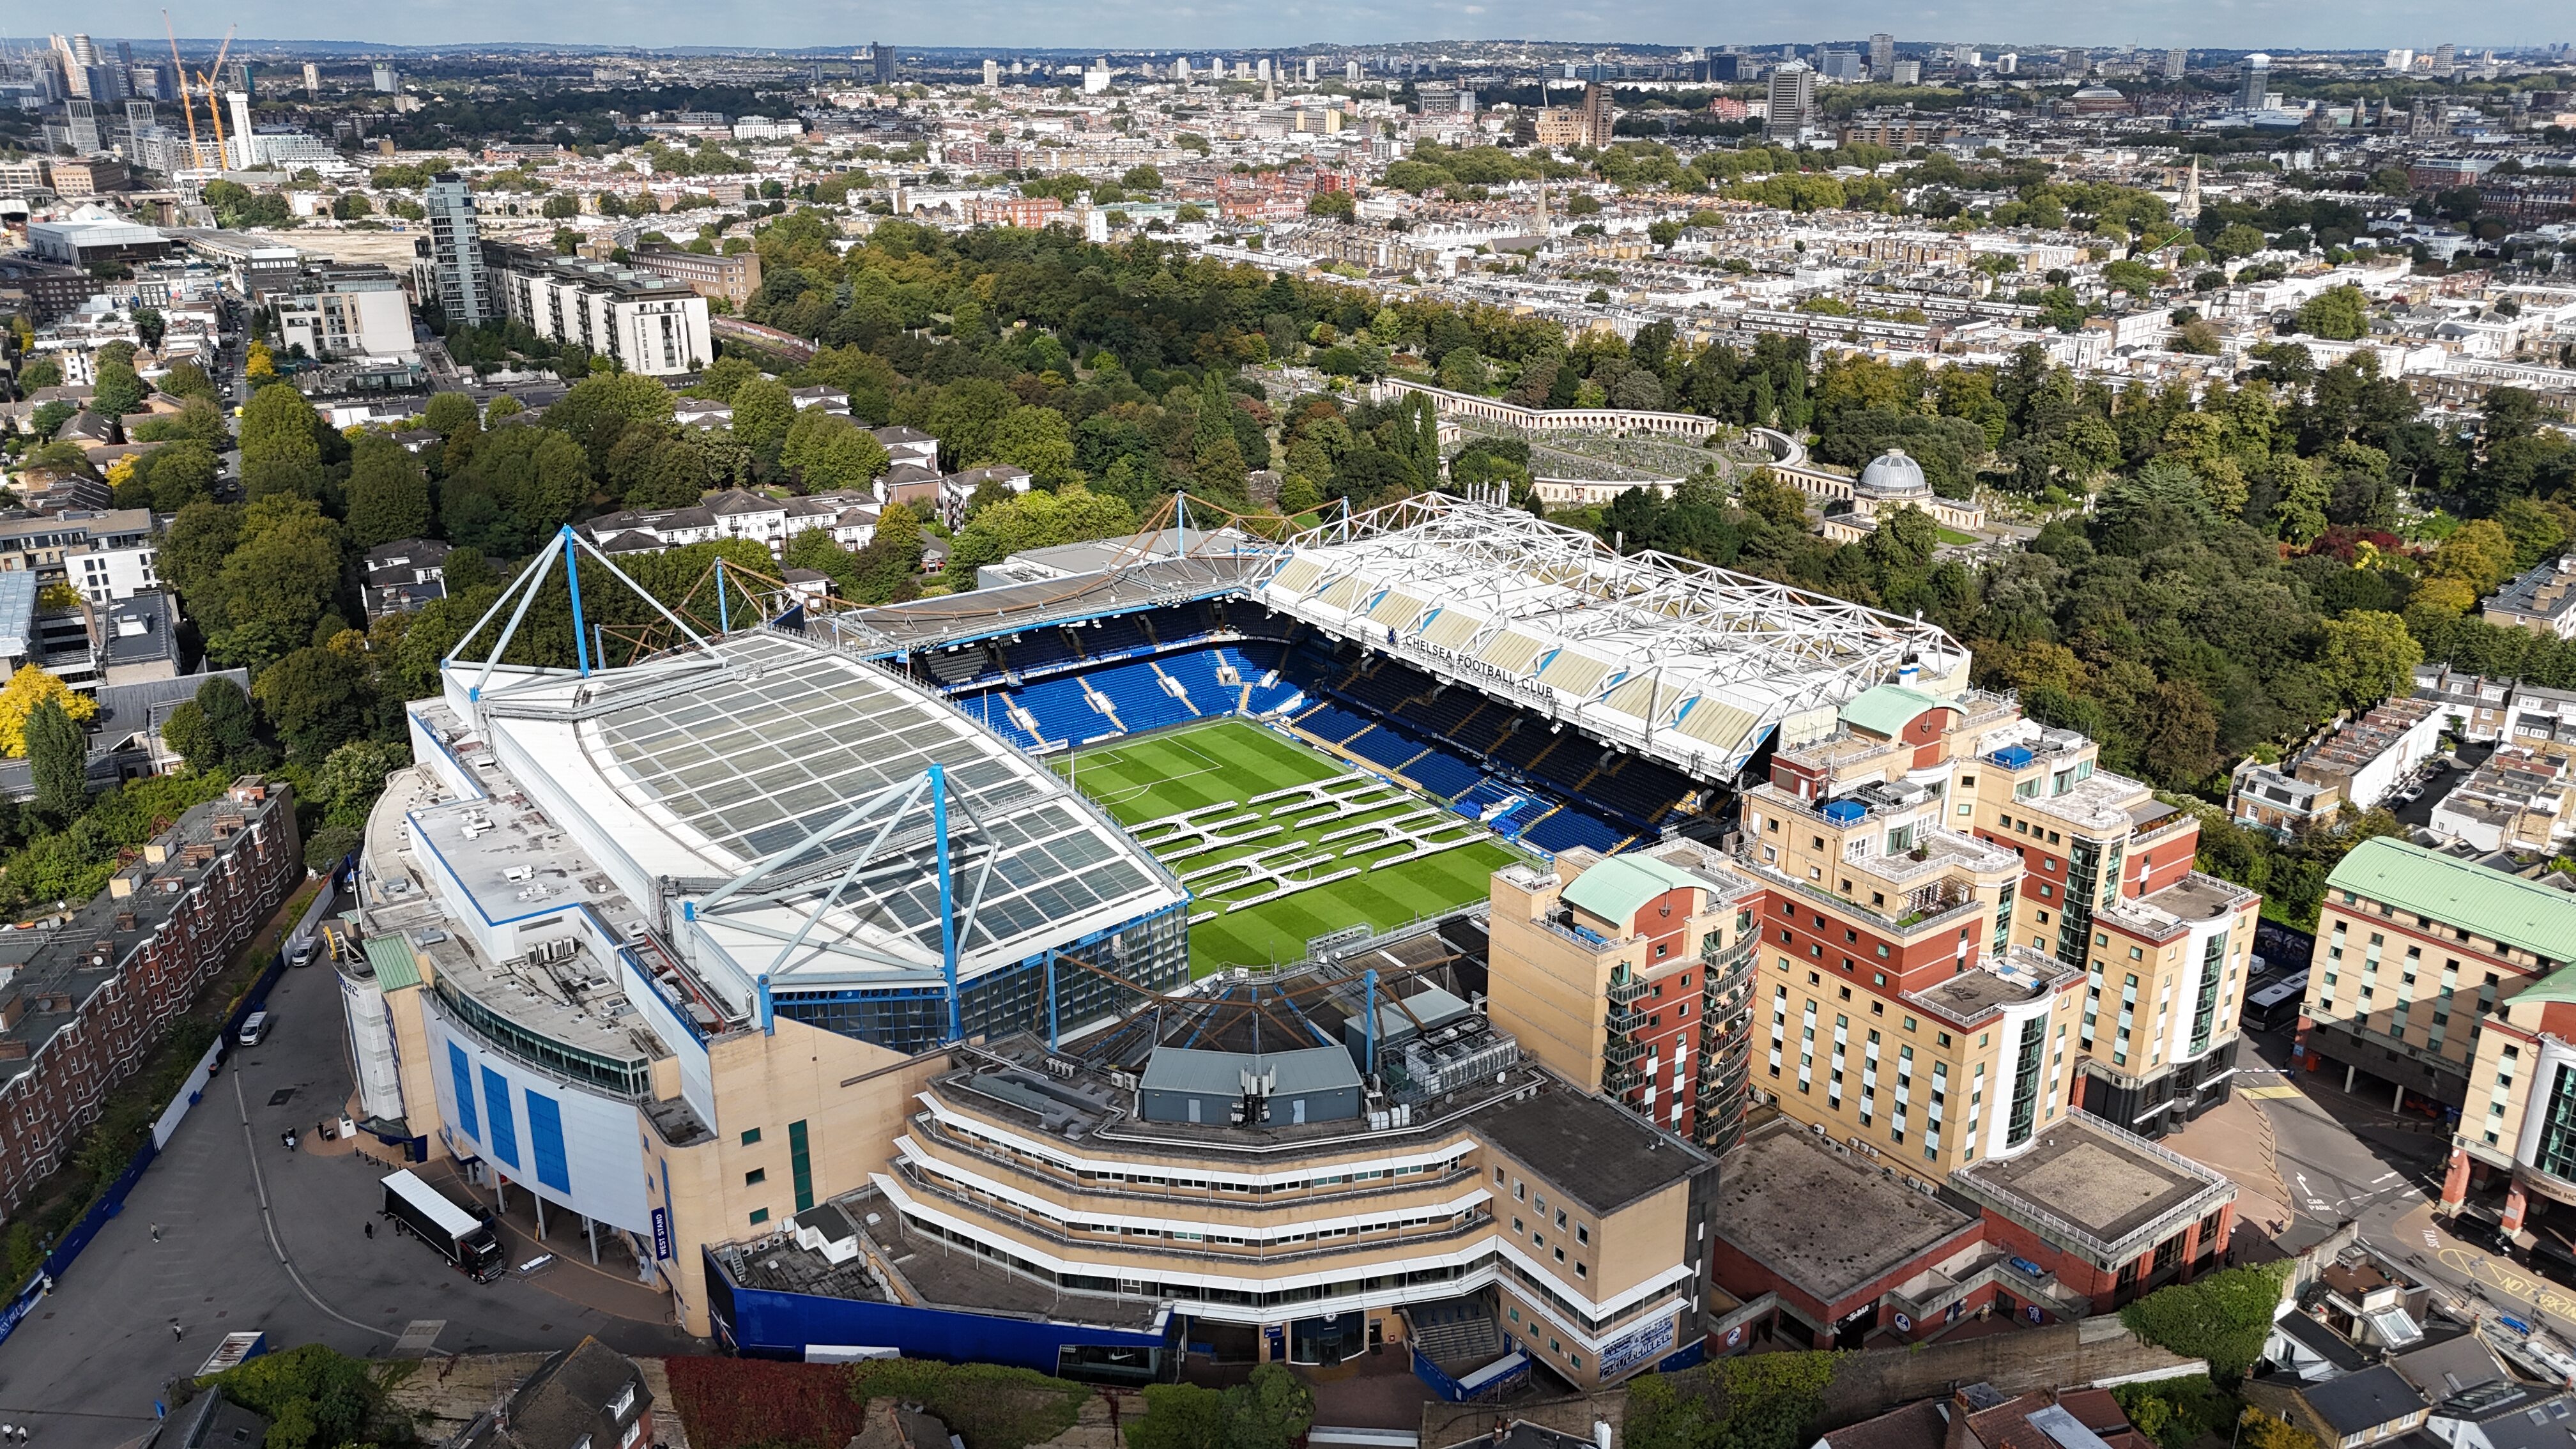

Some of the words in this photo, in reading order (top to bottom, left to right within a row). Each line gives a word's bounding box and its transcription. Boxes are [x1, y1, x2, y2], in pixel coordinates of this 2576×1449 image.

[1406, 635, 1452, 663] CHELSEA
[1457, 654, 1516, 685] FOOTBALL
[1522, 678, 1553, 698] CLUB
[656, 1214, 664, 1236] STAND
[657, 1238, 667, 1256] WEST
[2421, 1230, 2441, 1248] TAXIS
[2500, 1277, 2524, 1291] NO
